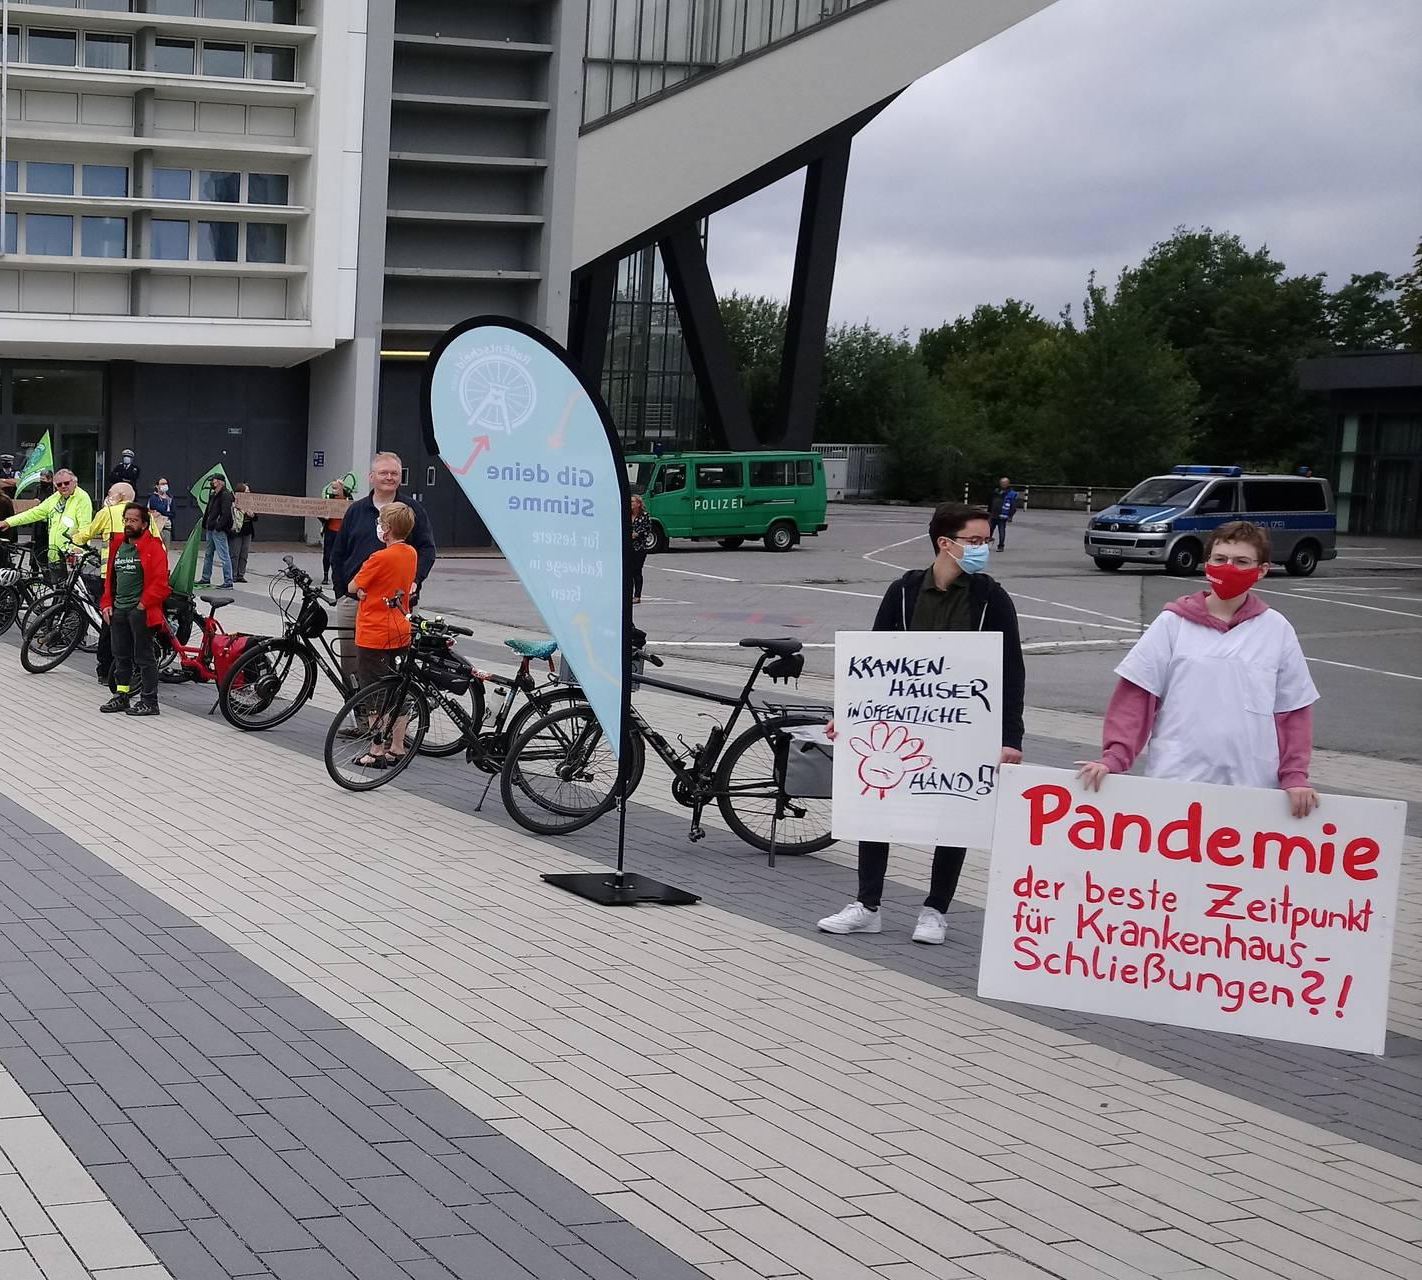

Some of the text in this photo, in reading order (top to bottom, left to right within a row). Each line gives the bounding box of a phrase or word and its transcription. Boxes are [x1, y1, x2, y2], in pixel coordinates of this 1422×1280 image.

[694, 498, 743, 510] POLIZEI
[848, 656, 951, 679] KRANKEN-
[889, 678, 991, 712] HÄUSER
[428, 685, 465, 728] COLUMBUS
[1021, 784, 1380, 881] Pandemie
[1013, 865, 1374, 940] der beste Zeitpunkt
[1013, 901, 1331, 968] für Krankenhaus-
[1014, 936, 1353, 1018] Schließungen?!
